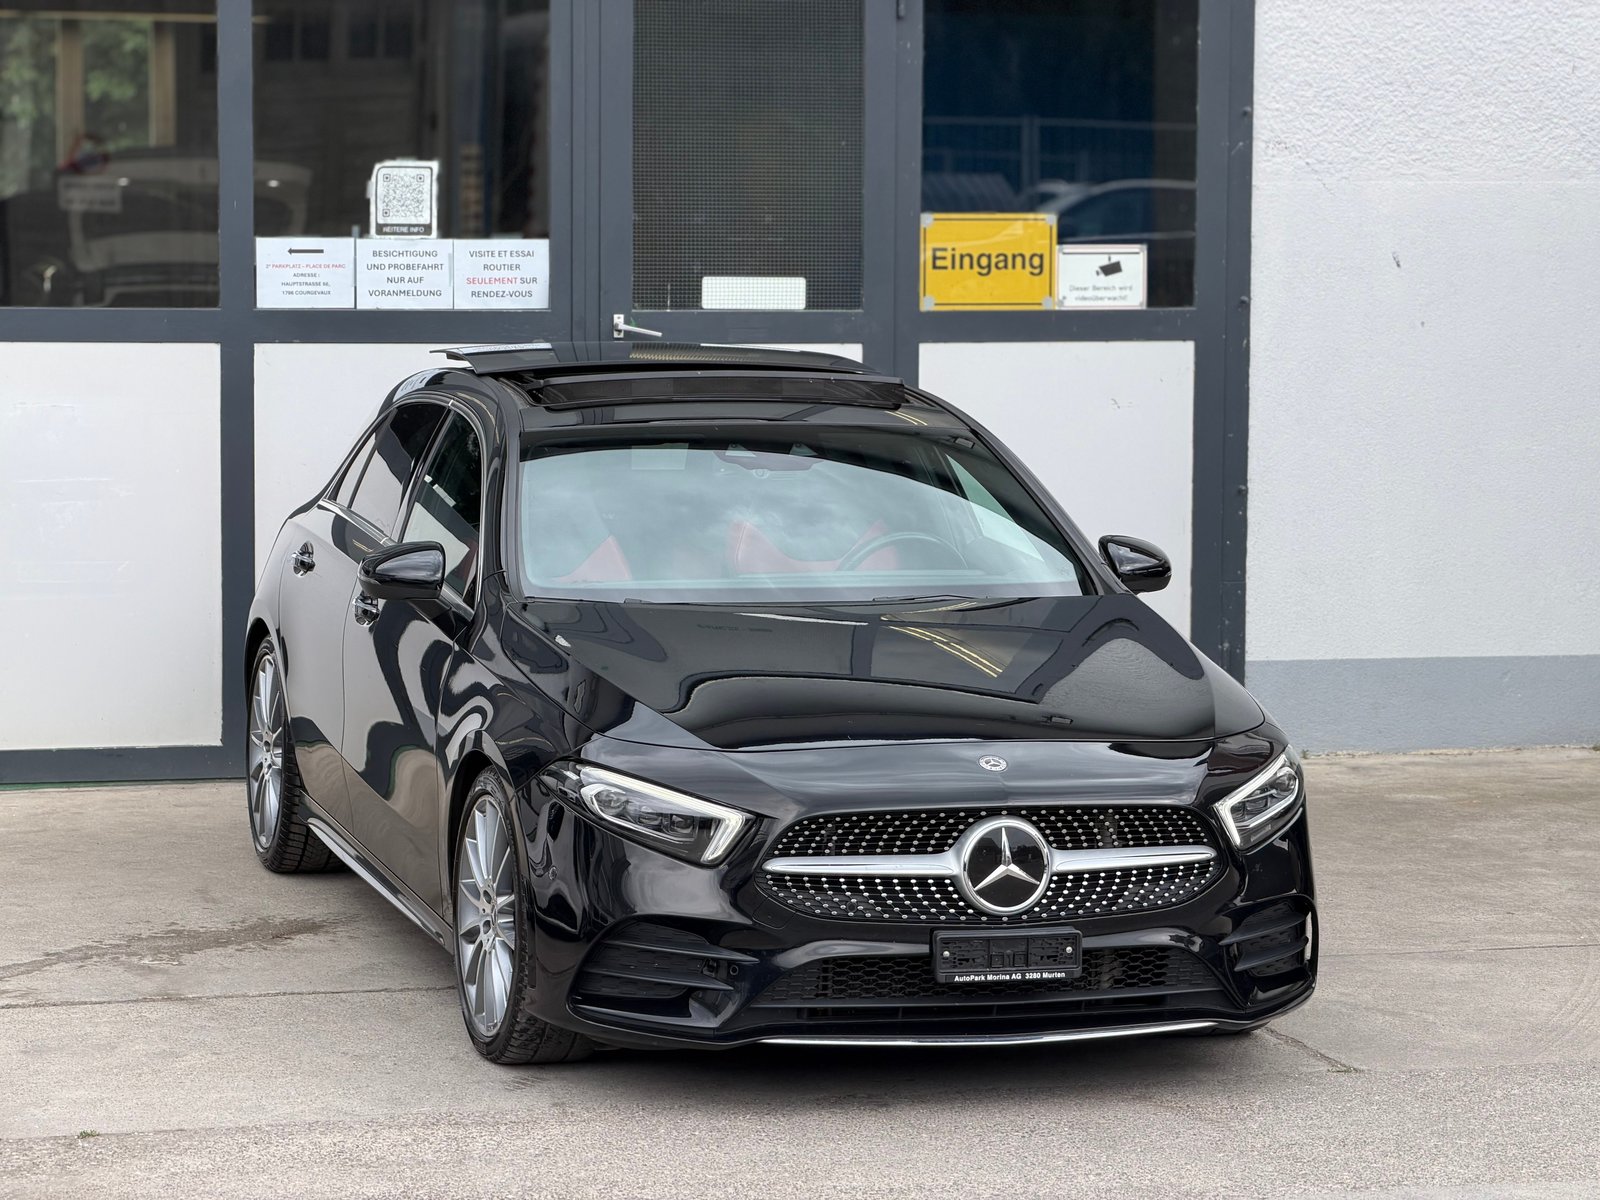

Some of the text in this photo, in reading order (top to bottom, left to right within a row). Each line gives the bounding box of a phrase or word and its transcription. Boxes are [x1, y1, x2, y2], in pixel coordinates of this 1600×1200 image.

[932, 247, 1044, 277] Eingang
[368, 289, 442, 297] VORANMELDUNG
[471, 290, 533, 298] RENDEZ-VOUS
[954, 974, 986, 982] AutoPark
